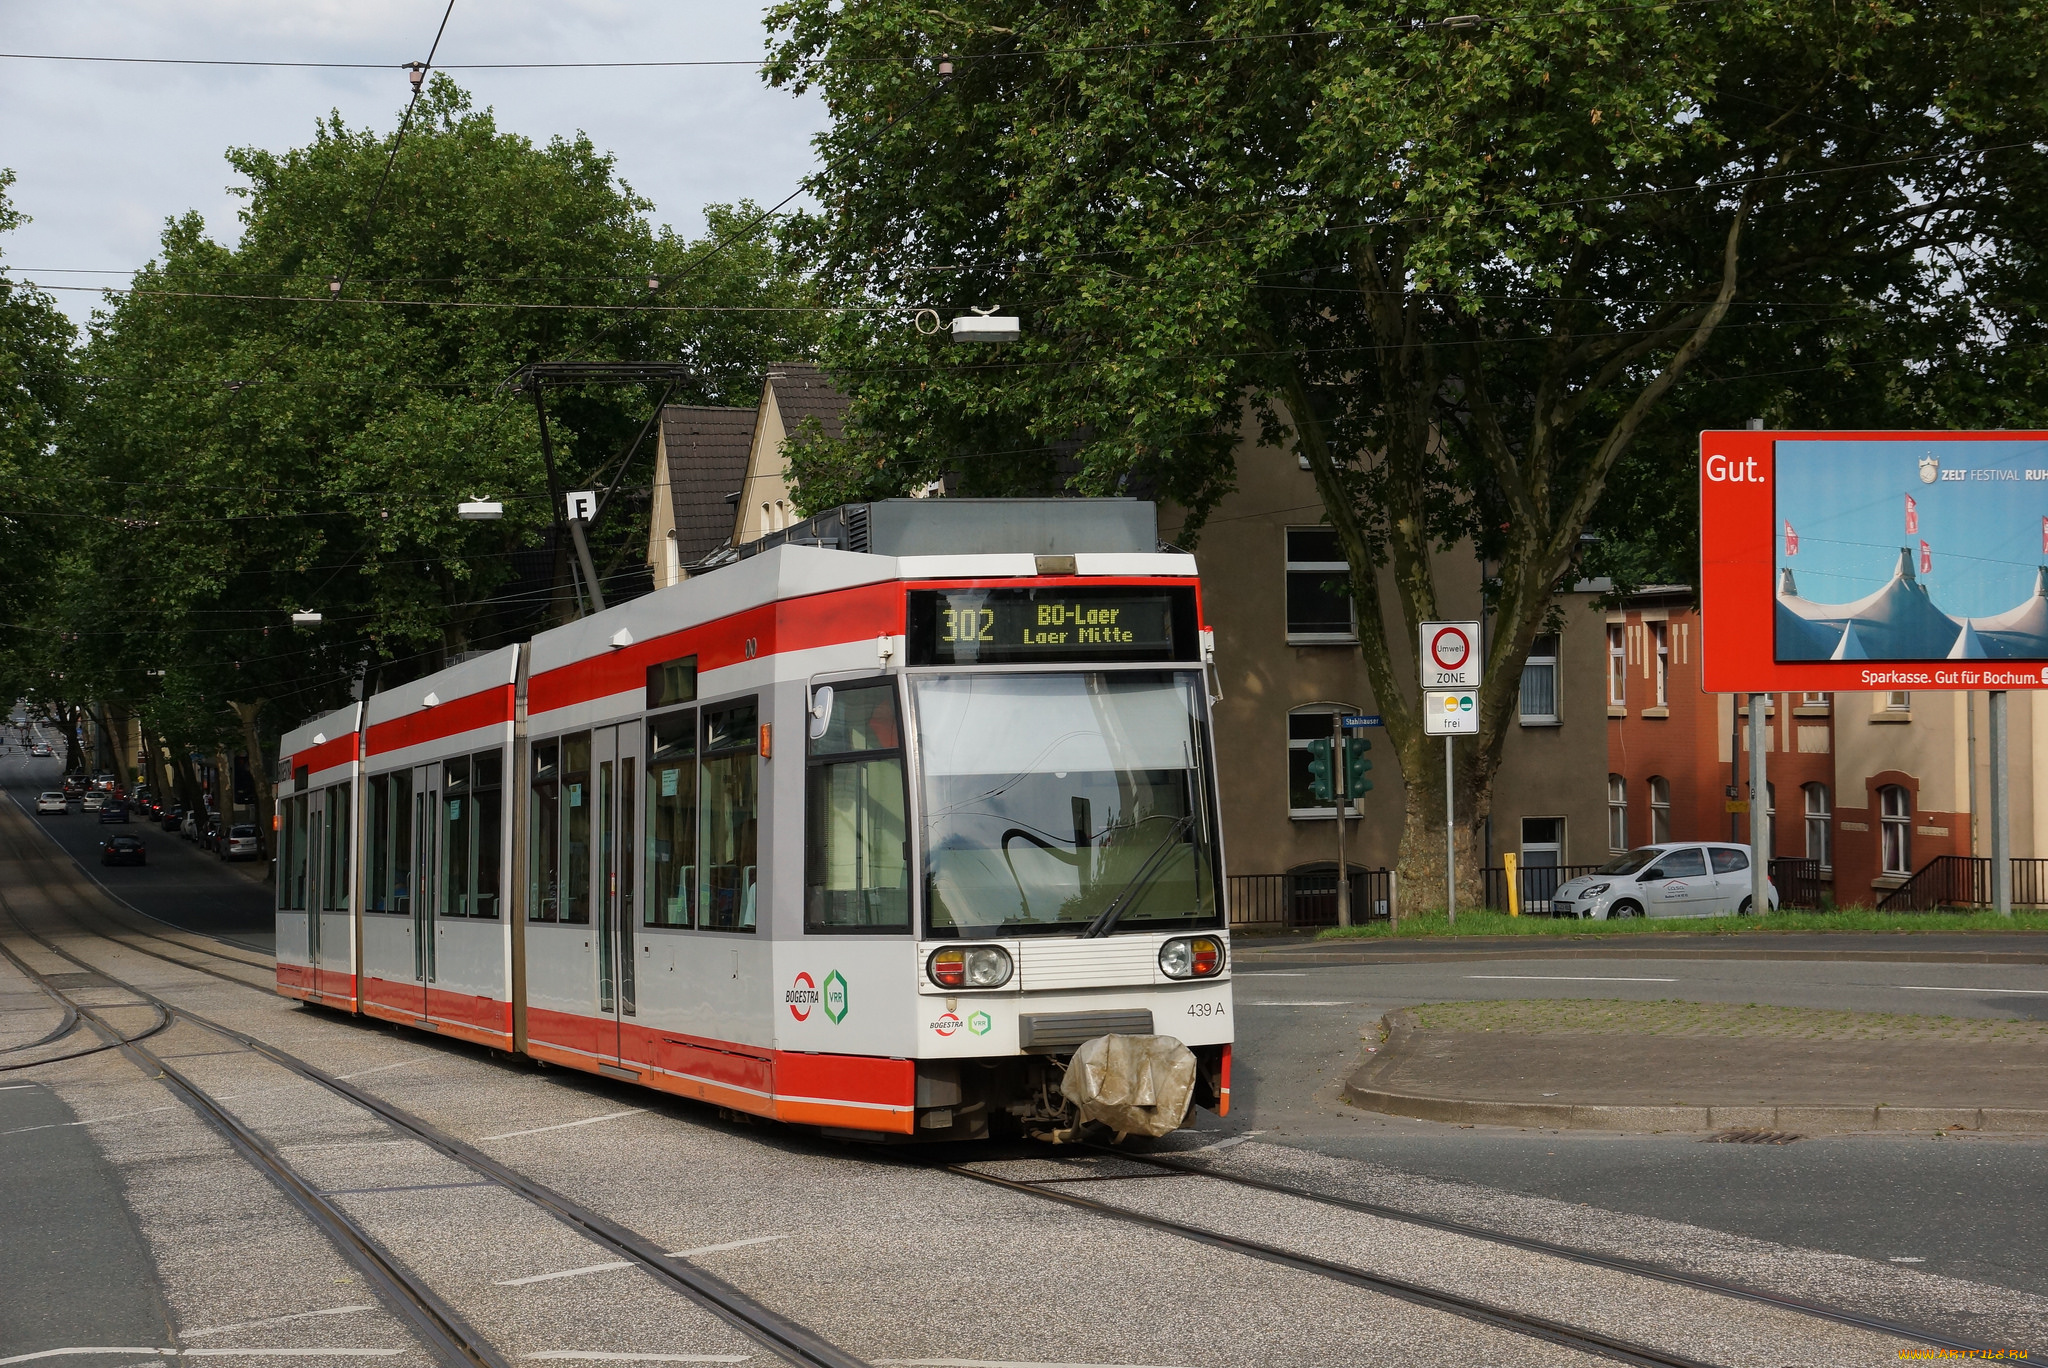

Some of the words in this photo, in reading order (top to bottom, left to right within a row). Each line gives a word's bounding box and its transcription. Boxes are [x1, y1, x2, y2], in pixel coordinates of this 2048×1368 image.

[1706, 454, 1765, 482] Gut.
[1941, 469, 1967, 481] ZELT
[1970, 469, 2020, 481] FESTIVAL
[575, 498, 589, 520] E
[942, 608, 994, 641] 302
[1037, 604, 1120, 625] BO-Laer
[1023, 628, 1069, 644] Laer
[1078, 626, 1133, 643] Mitte
[1437, 645, 1464, 653] Umwelt
[1436, 673, 1465, 683] ZONE
[1861, 670, 1932, 686] Sparkasse.
[1935, 671, 1958, 684] Gut
[1961, 671, 1981, 684] für
[1983, 671, 2039, 685] Bochum.
[1444, 719, 1460, 728] frei
[785, 990, 819, 1003] BOGESTRA
[829, 991, 843, 1003] VRR
[1187, 1003, 1212, 1017] 439
[1215, 1002, 1225, 1015] A
[929, 1020, 964, 1029] BOGESTRA
